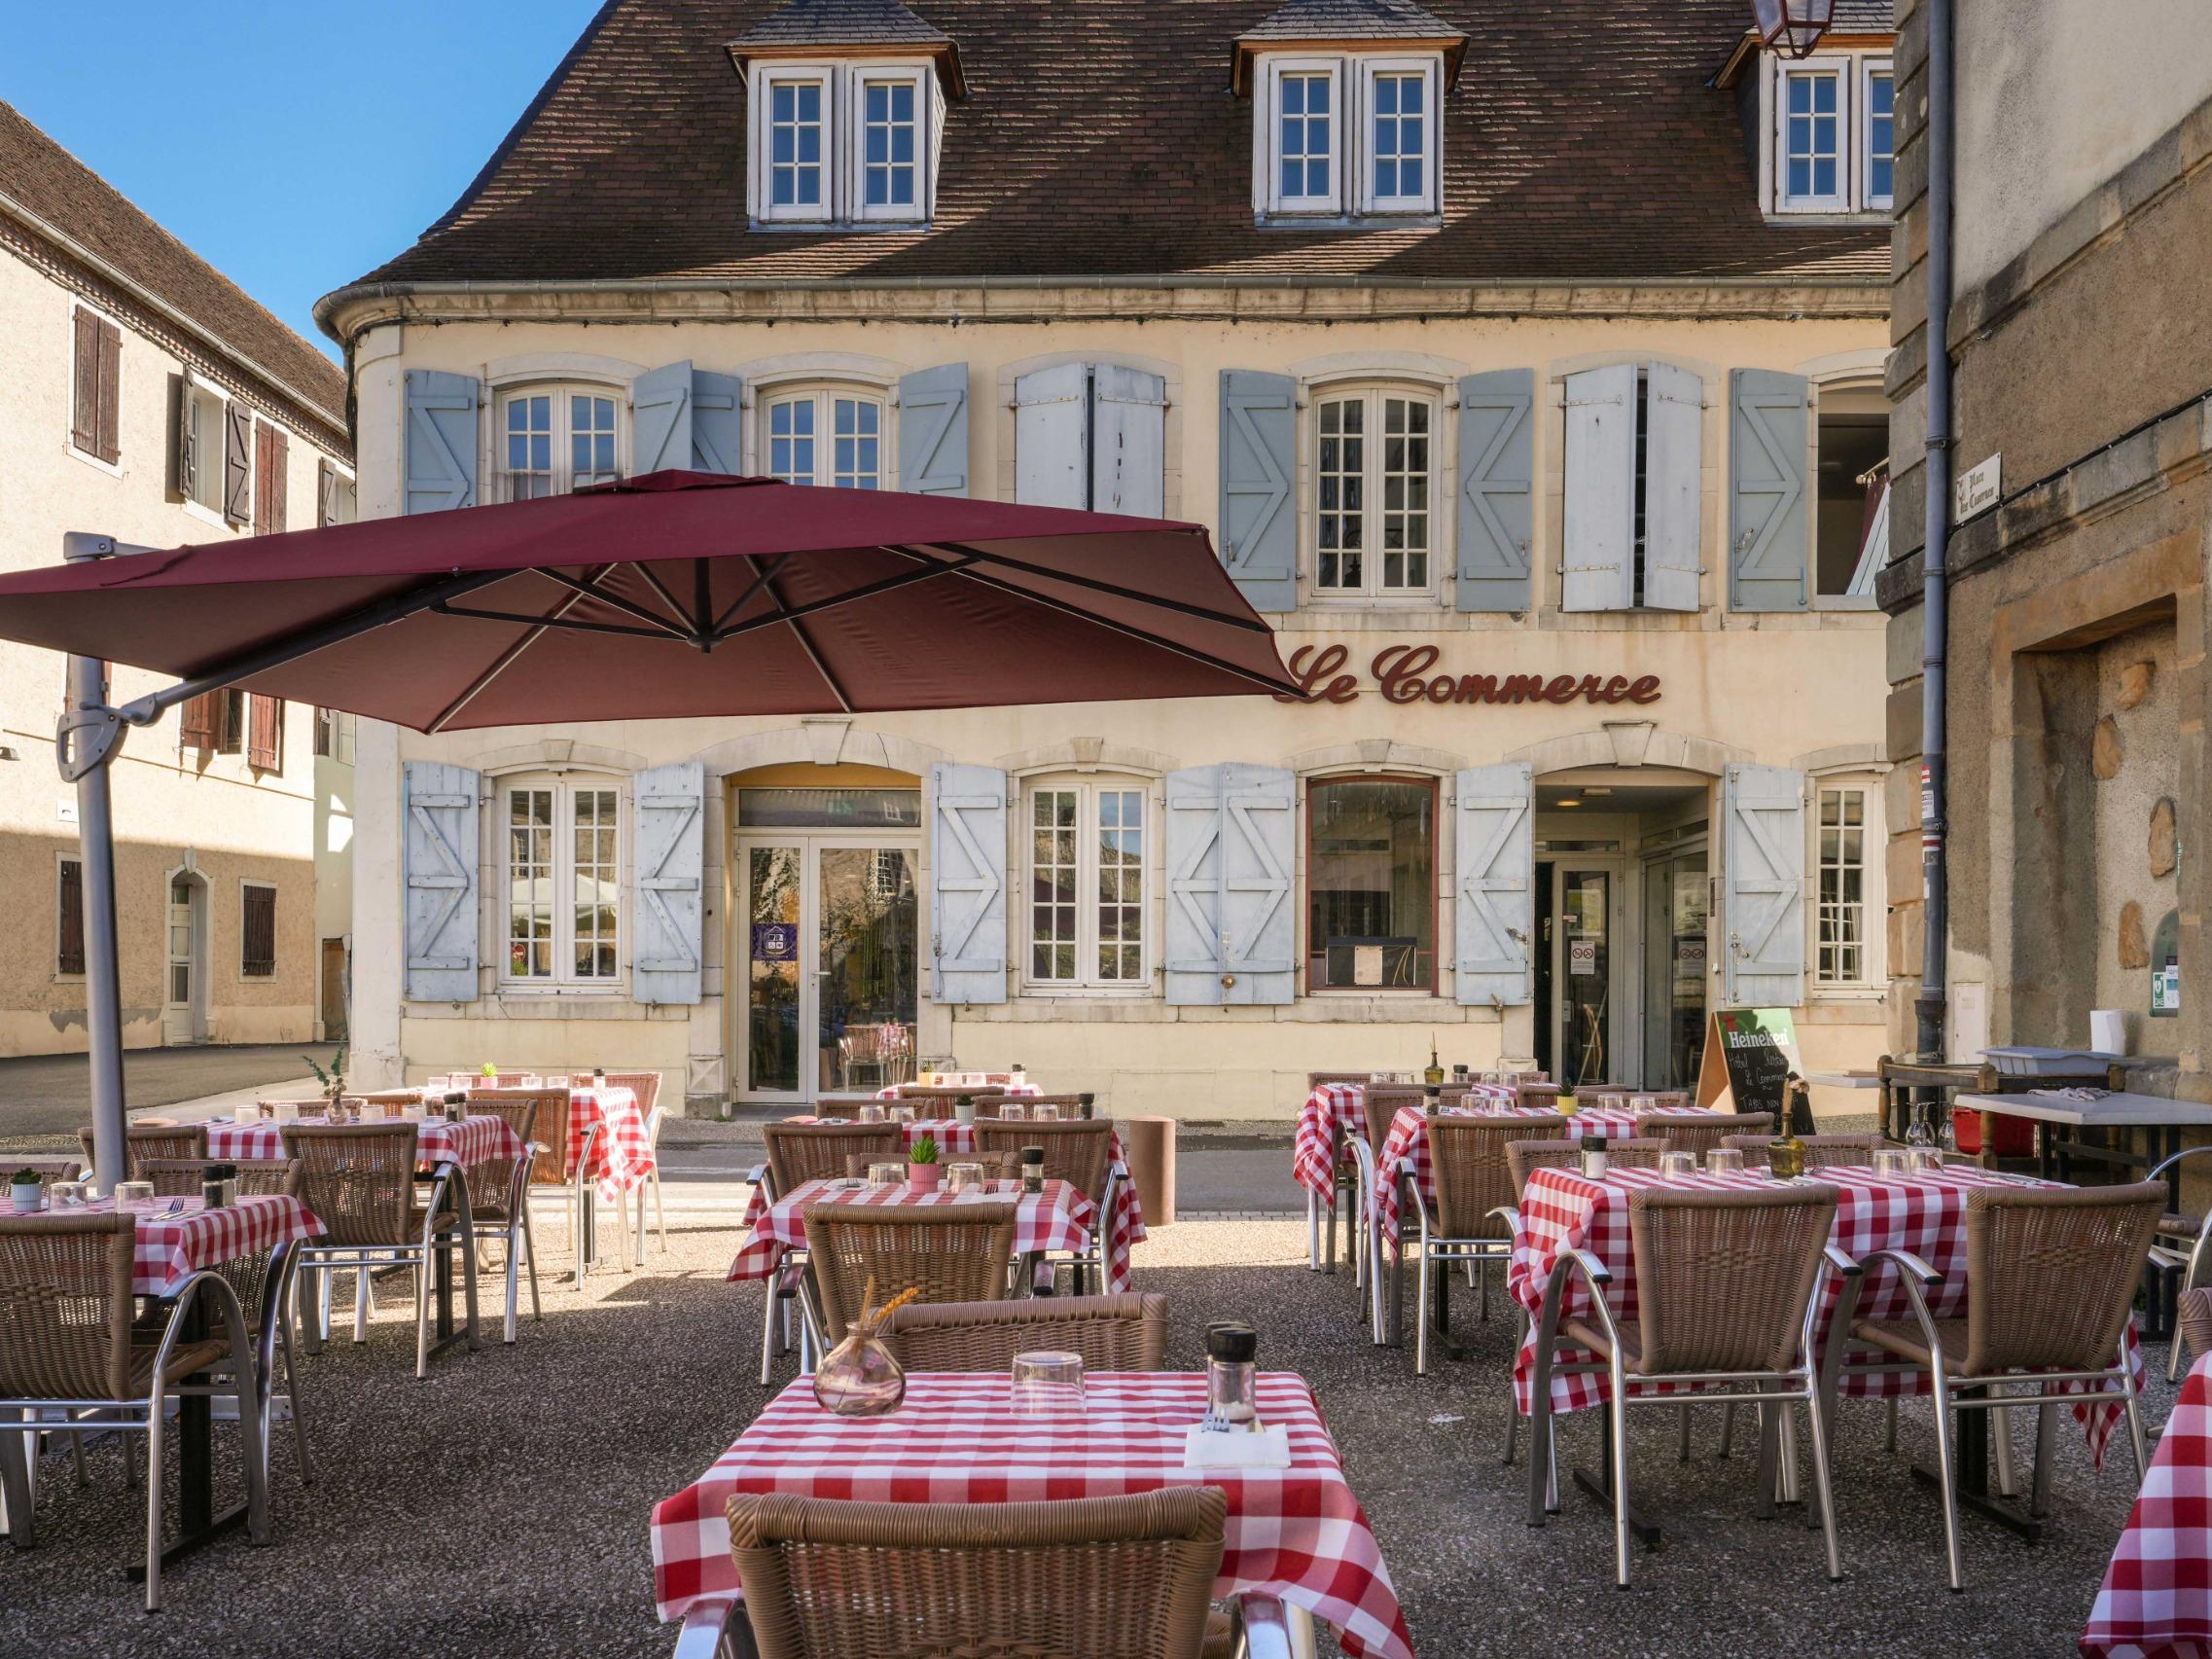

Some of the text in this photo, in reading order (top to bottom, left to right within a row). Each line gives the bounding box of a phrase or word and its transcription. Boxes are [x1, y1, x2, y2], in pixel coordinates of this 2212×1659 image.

[1272, 644, 1662, 704] Le Commerce
[1729, 1028, 1790, 1049] Heineken
